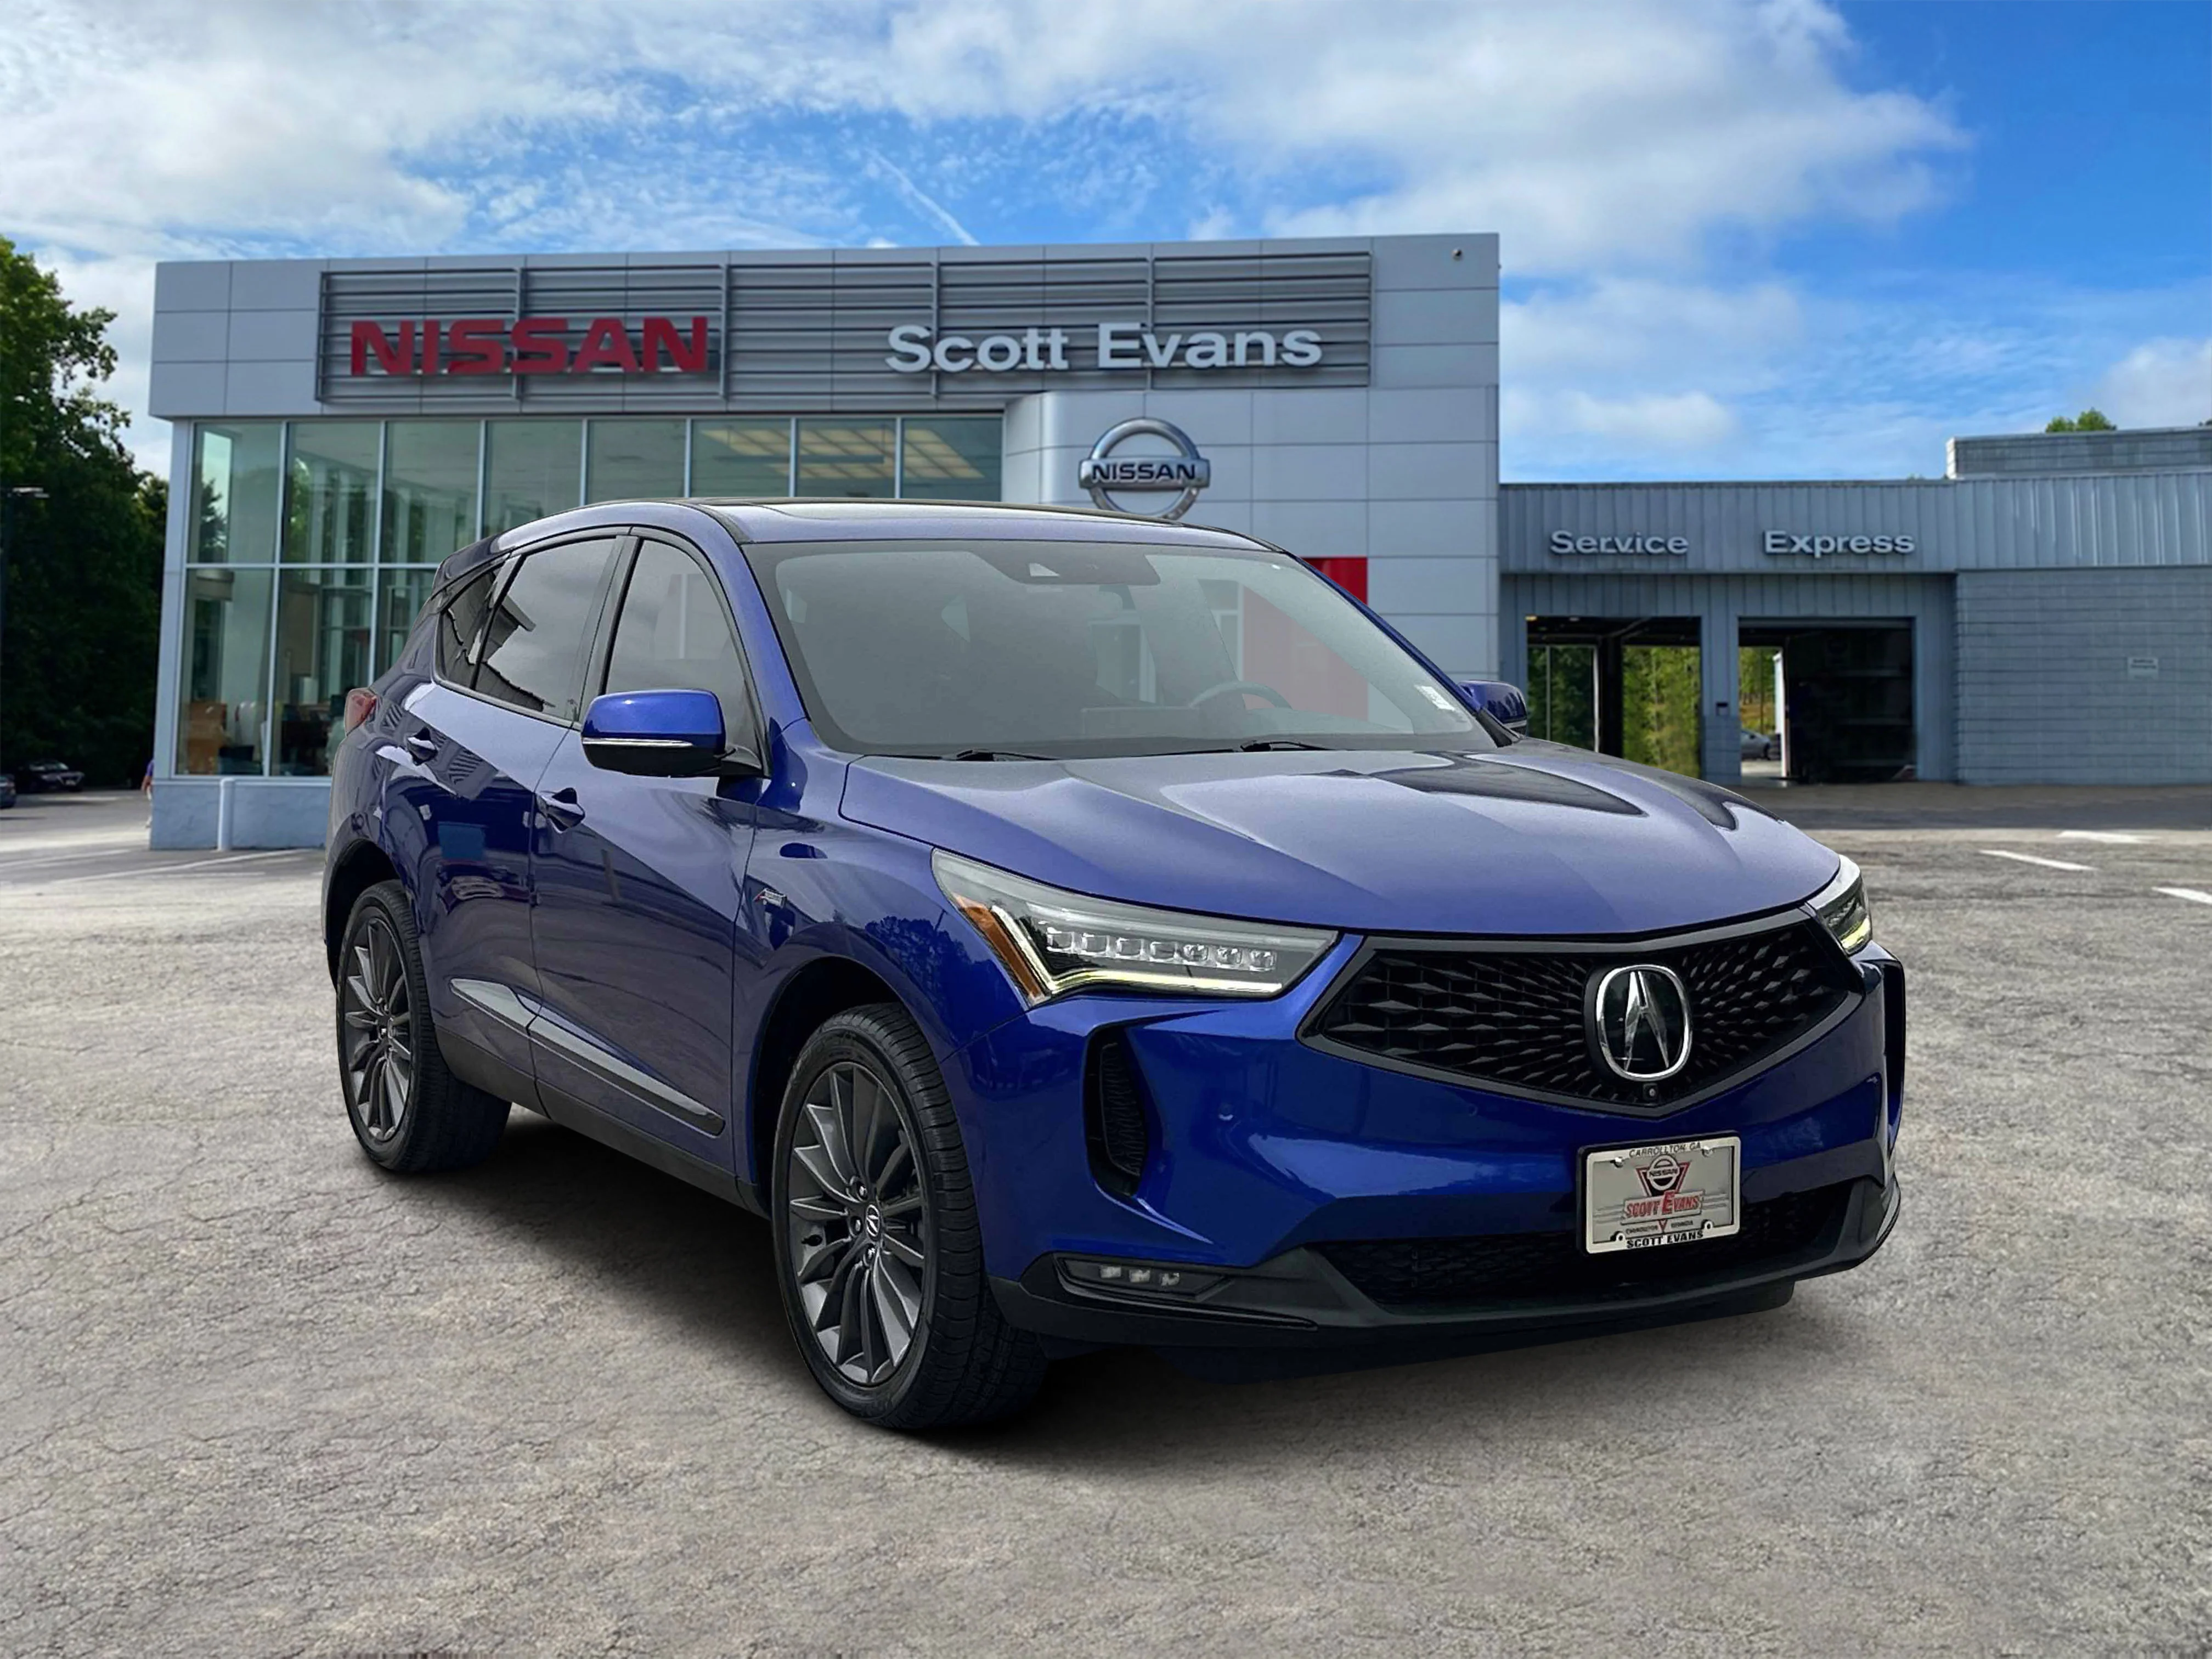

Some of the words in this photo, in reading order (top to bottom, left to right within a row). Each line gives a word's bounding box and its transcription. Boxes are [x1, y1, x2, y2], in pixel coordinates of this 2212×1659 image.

[351, 315, 708, 375] NISSAN
[885, 324, 1069, 373] Scott
[1098, 322, 1323, 369] Evans
[1093, 464, 1195, 481] NISSAN
[1550, 530, 1689, 555] Service
[1764, 530, 1915, 558] Express
[1629, 1144, 1686, 1157] CARROLLTON
[1690, 1142, 1701, 1151] GA
[1649, 1169, 1678, 1177] NISSAN
[1626, 1200, 1661, 1218] SCOTT
[1662, 1192, 1700, 1214] EVANS
[1627, 1235, 1663, 1249] SCOTT
[1667, 1230, 1703, 1244] EVANS
